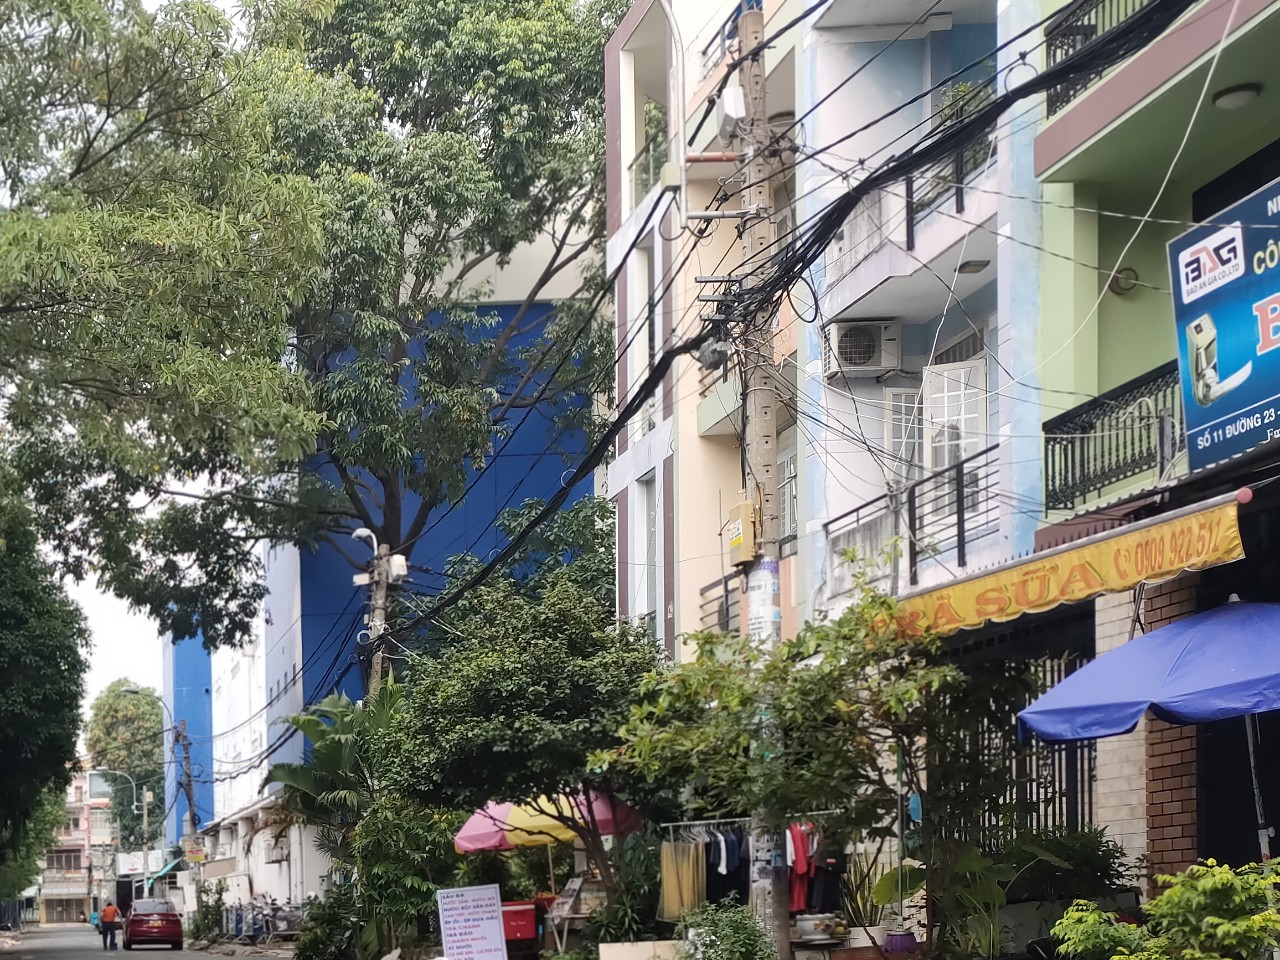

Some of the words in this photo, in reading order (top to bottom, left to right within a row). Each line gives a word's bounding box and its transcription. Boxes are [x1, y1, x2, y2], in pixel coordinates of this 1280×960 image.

[1197, 428, 1211, 450] SỐ
[1213, 429, 1223, 443] 11
[1225, 413, 1262, 438] ĐƯỜNG
[1263, 408, 1276, 424] 23
[974, 560, 1108, 619] SỮA
[1134, 534, 1165, 577] 0909
[1169, 526, 1193, 567] 922
